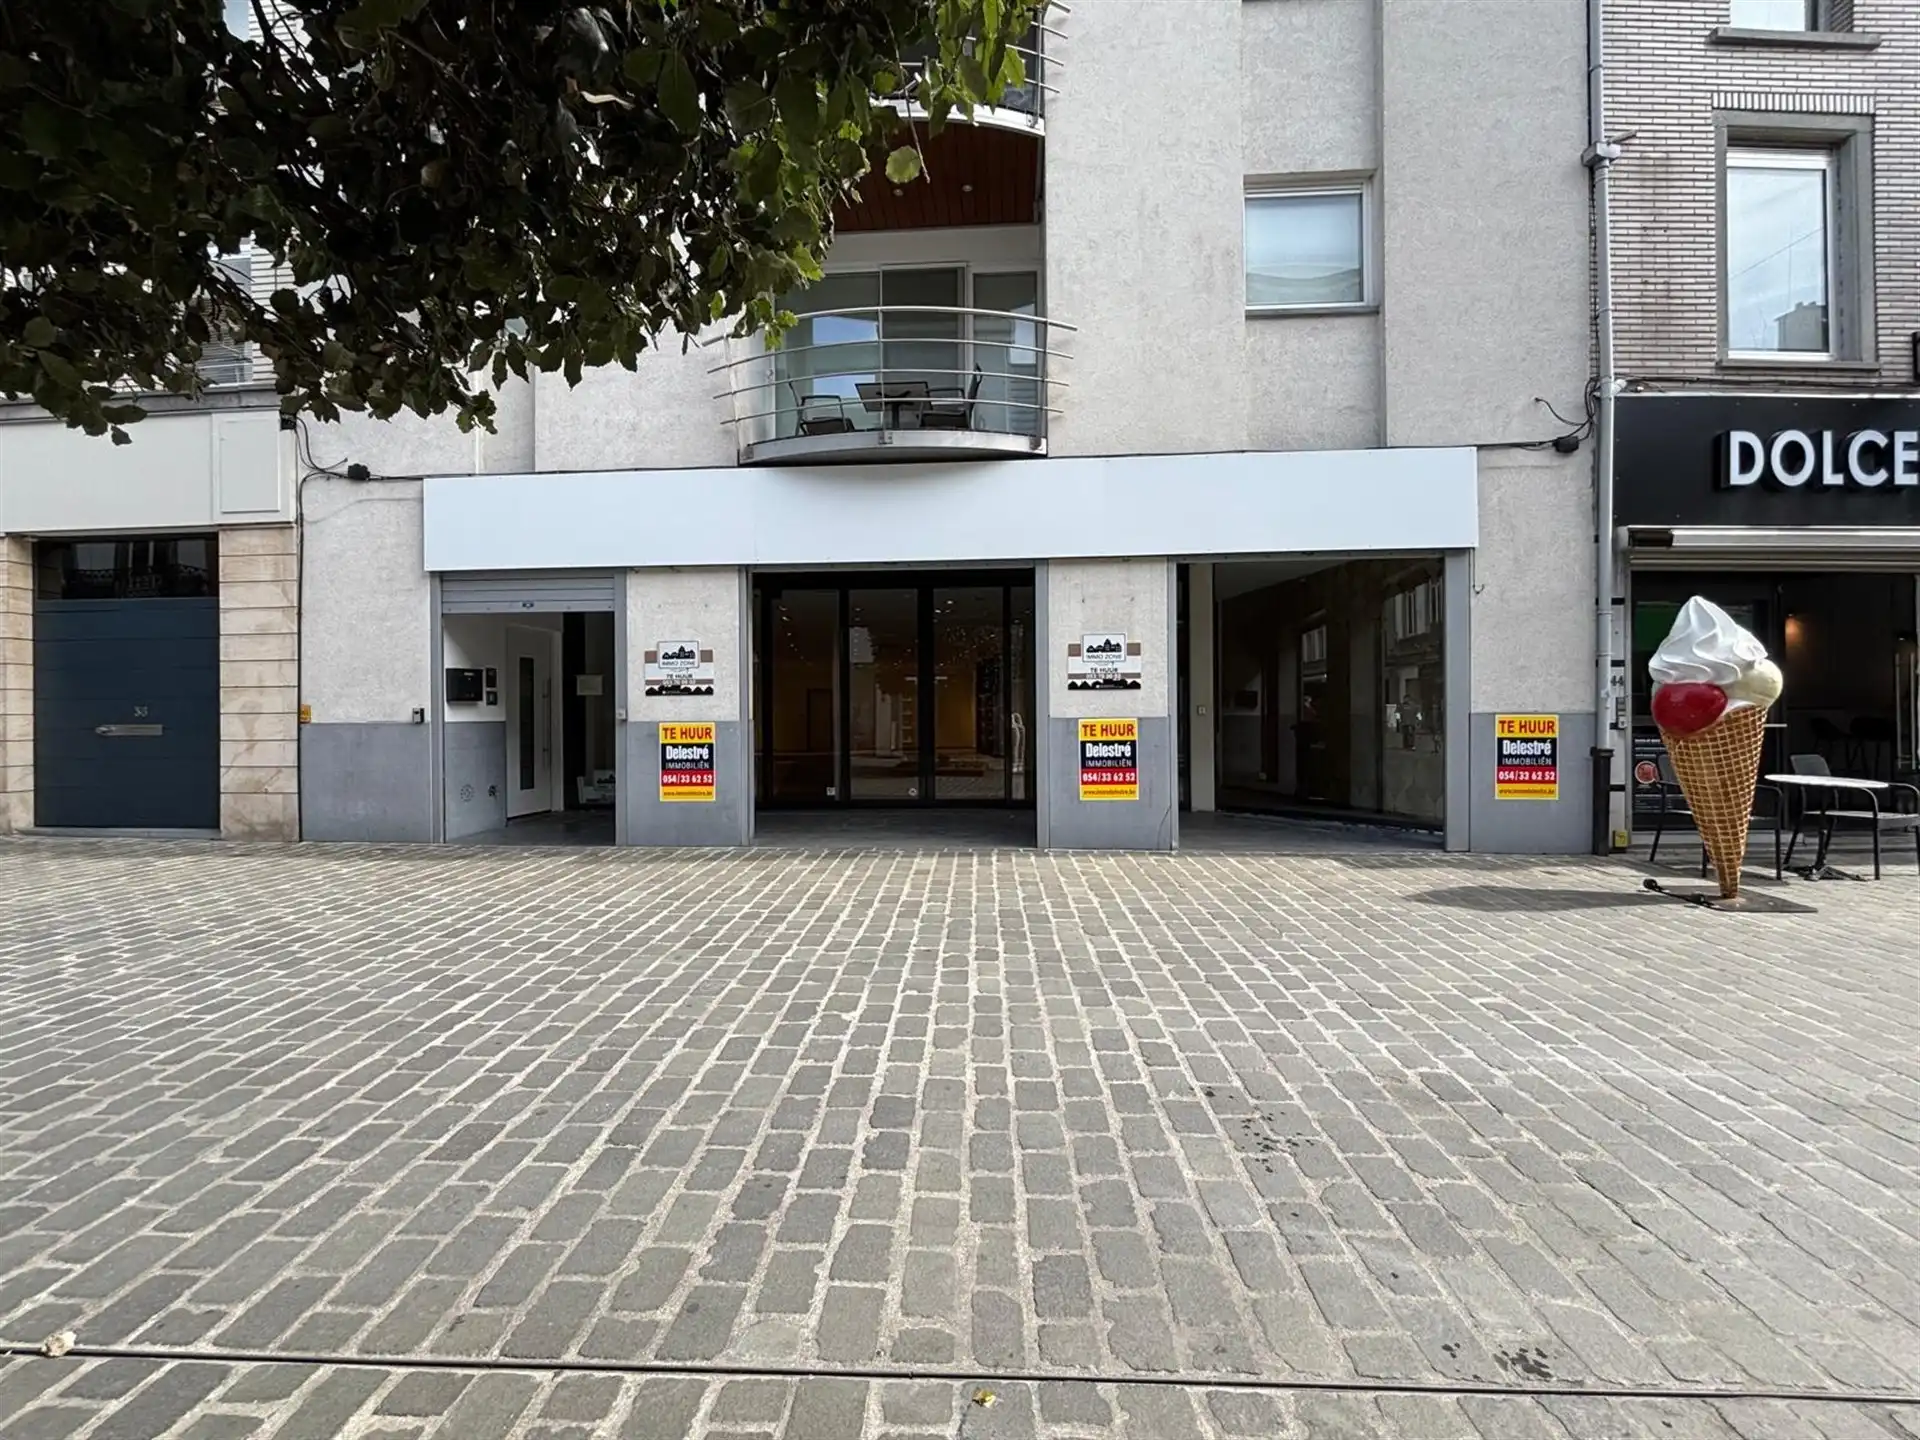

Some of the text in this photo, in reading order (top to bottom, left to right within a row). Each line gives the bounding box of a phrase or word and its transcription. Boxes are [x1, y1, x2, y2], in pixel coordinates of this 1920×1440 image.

[1729, 429, 1919, 487] DOLCE
[662, 727, 712, 739] TE HUUR
[1082, 724, 1134, 737] TE HUUR
[1498, 721, 1555, 733] TE HUUR
[666, 745, 709, 759] Delestré
[1086, 742, 1131, 757] Delestré
[1502, 740, 1551, 755] Delestré
[692, 774, 702, 784] 62
[703, 774, 713, 784] 52
[1113, 772, 1123, 782] 62
[1125, 772, 1135, 782] 52
[1531, 771, 1543, 780] 62
[1544, 771, 1555, 780] 52
